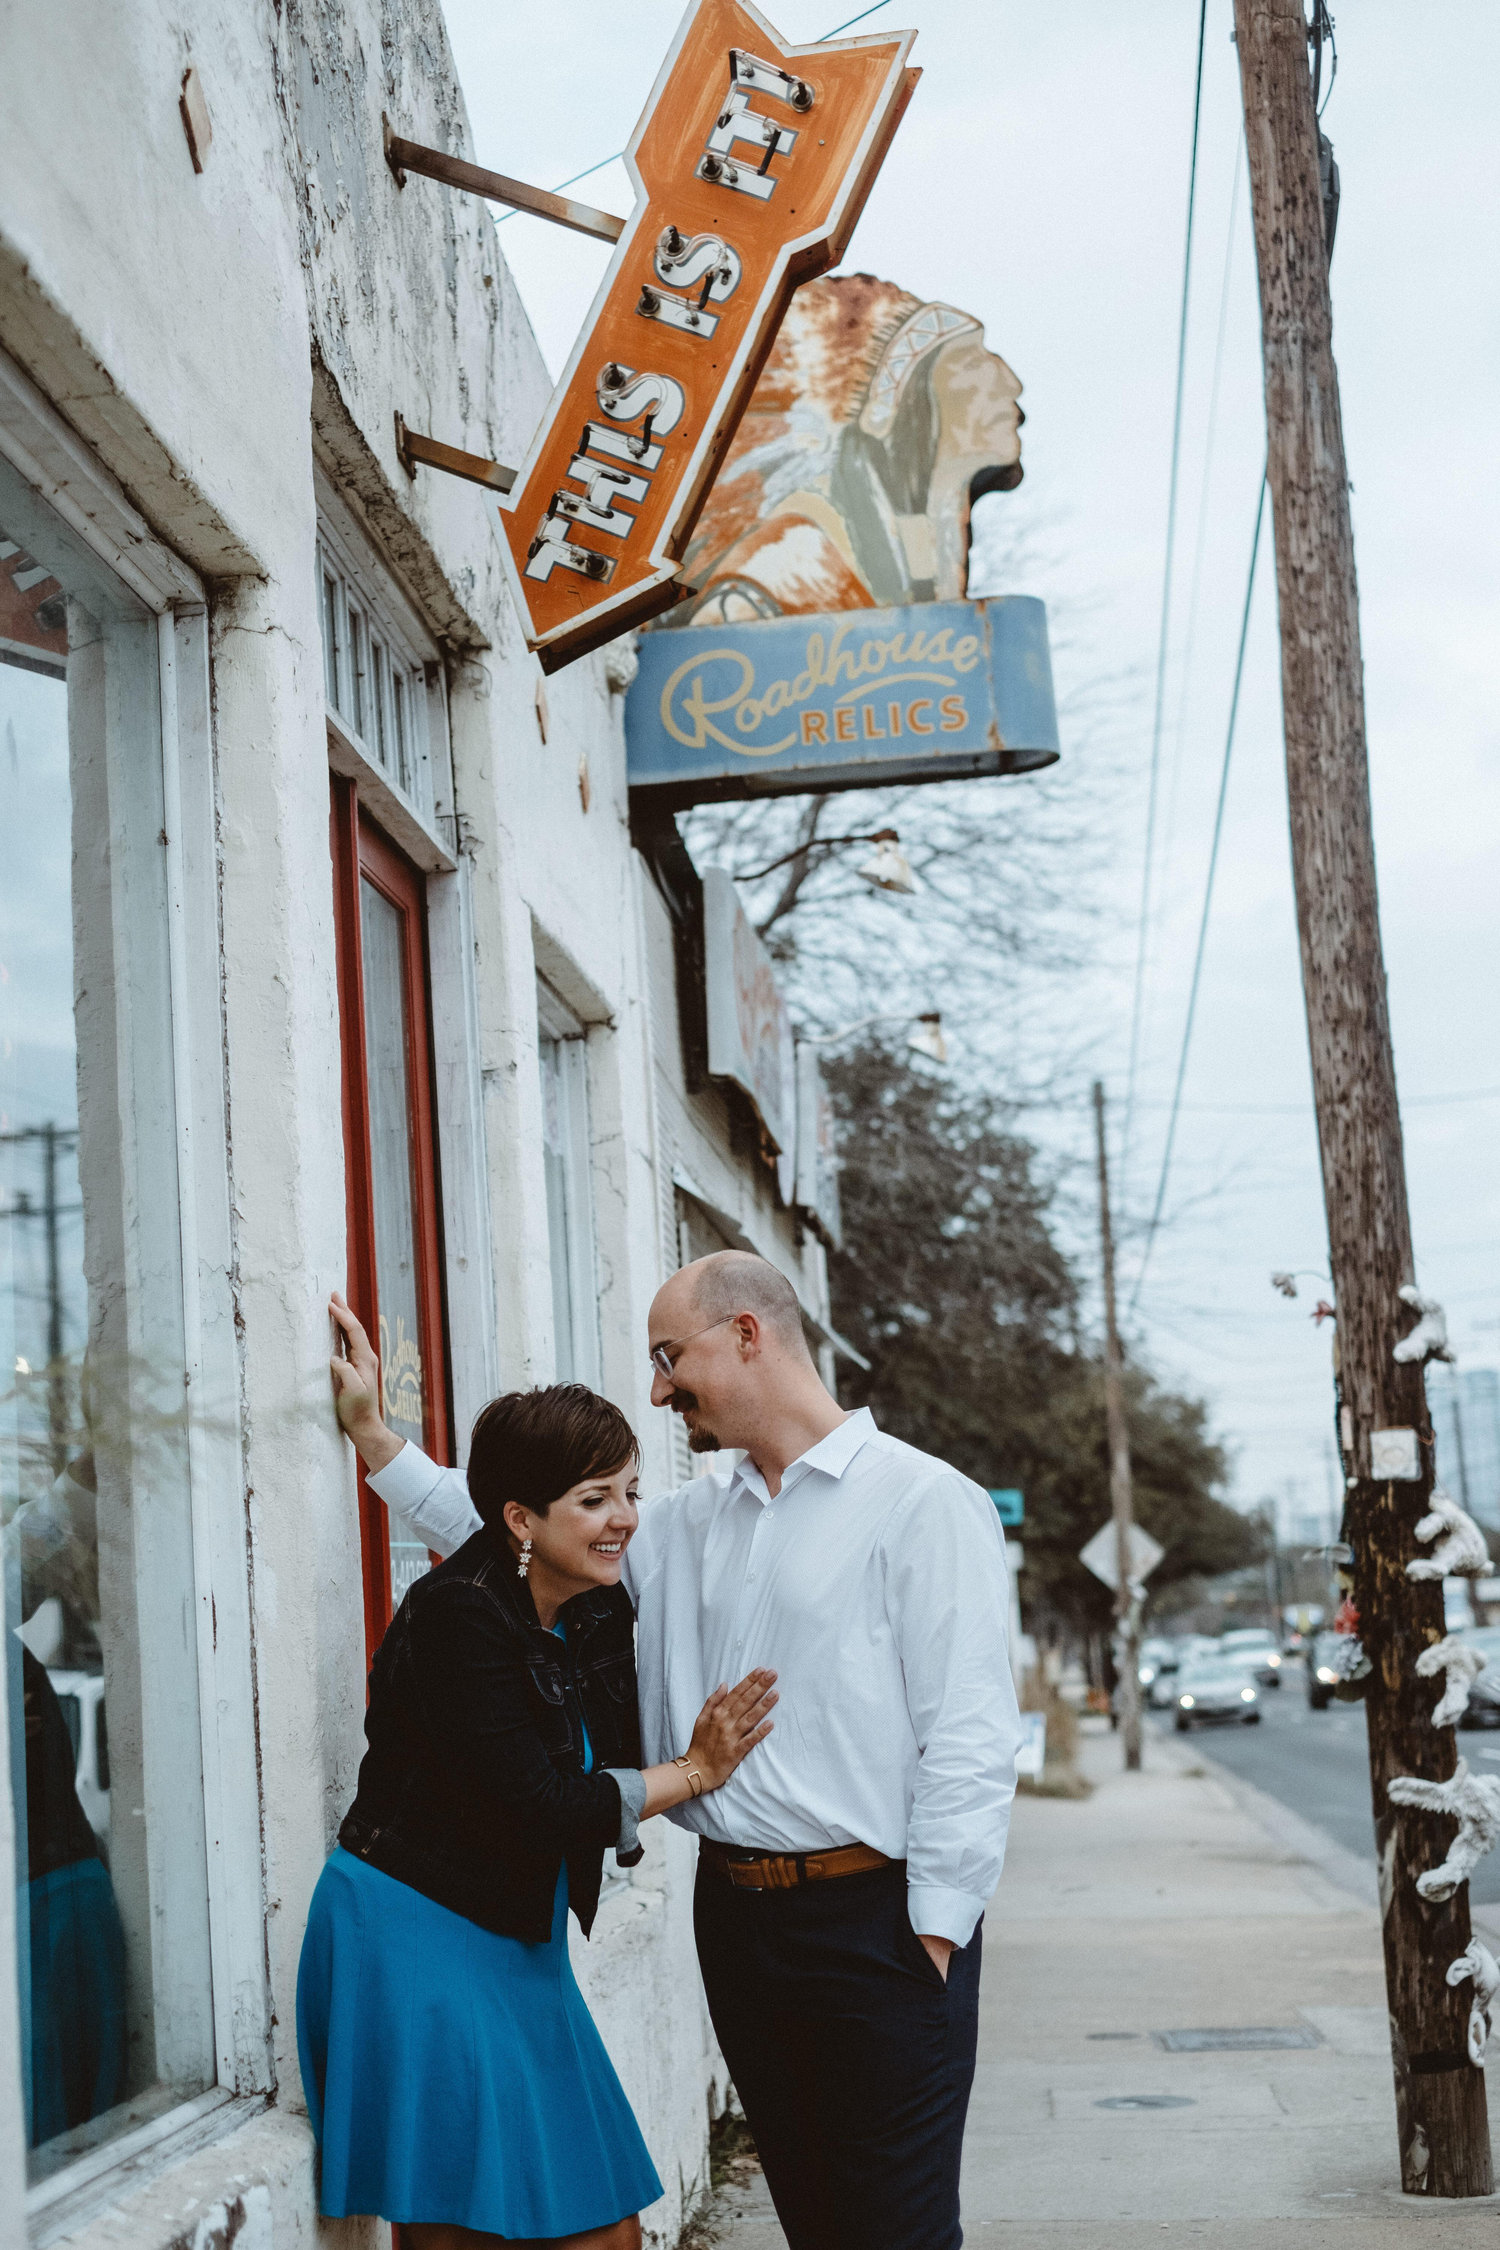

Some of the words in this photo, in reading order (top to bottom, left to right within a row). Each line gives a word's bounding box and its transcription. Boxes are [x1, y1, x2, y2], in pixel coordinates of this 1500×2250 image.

[523, 361, 685, 584] THIS
[633, 226, 741, 340] IS
[660, 623, 980, 756] Roadhouse
[802, 694, 969, 746] RELICS
